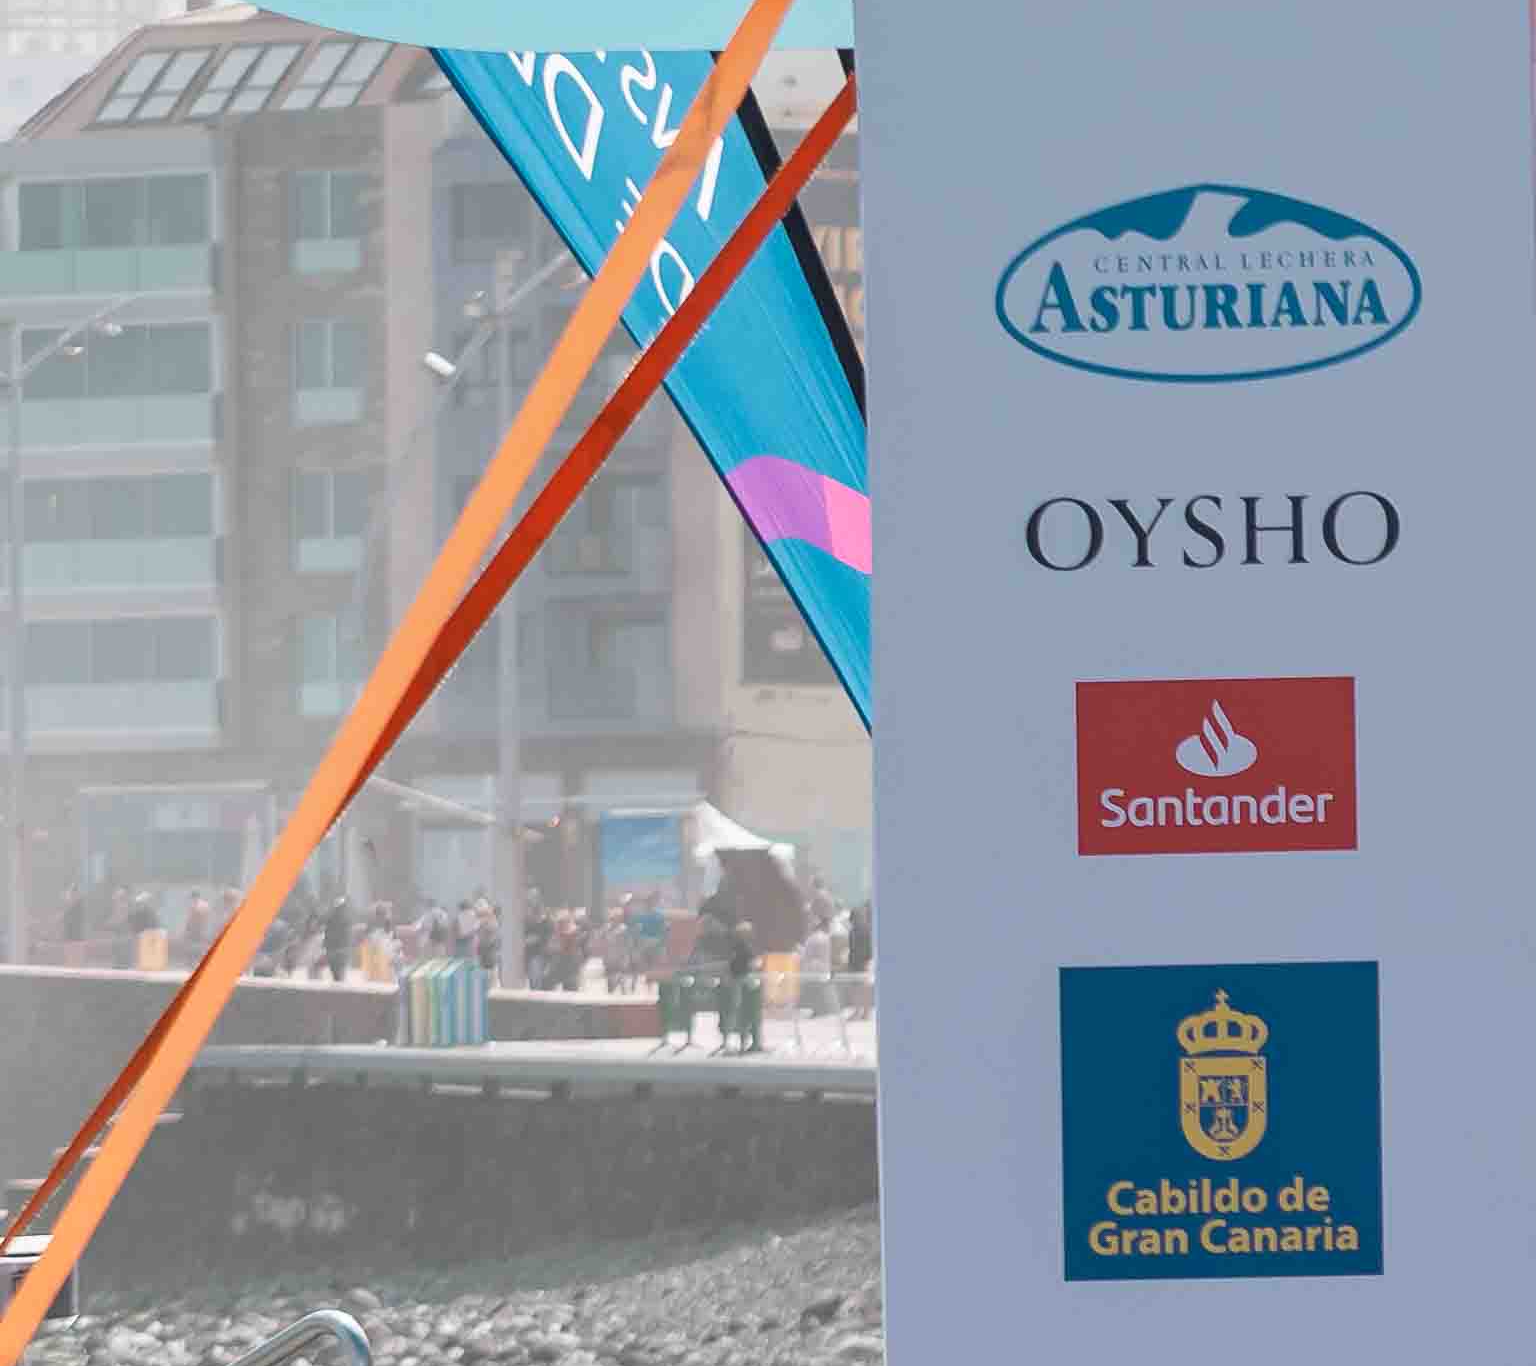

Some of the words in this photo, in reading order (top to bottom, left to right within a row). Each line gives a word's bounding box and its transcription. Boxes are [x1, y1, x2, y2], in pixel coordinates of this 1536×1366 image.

[1093, 253, 1224, 274] CENTRAL
[1240, 249, 1374, 271] LECHERA
[1030, 260, 1390, 335] ASTURIANA
[1025, 490, 1400, 573] OYSHO
[1100, 785, 1334, 828] Santander
[1107, 1177, 1267, 1216] Cabildo
[1279, 1176, 1330, 1213] de
[1089, 1220, 1189, 1256] Gran
[1200, 1216, 1358, 1255] Canaria
